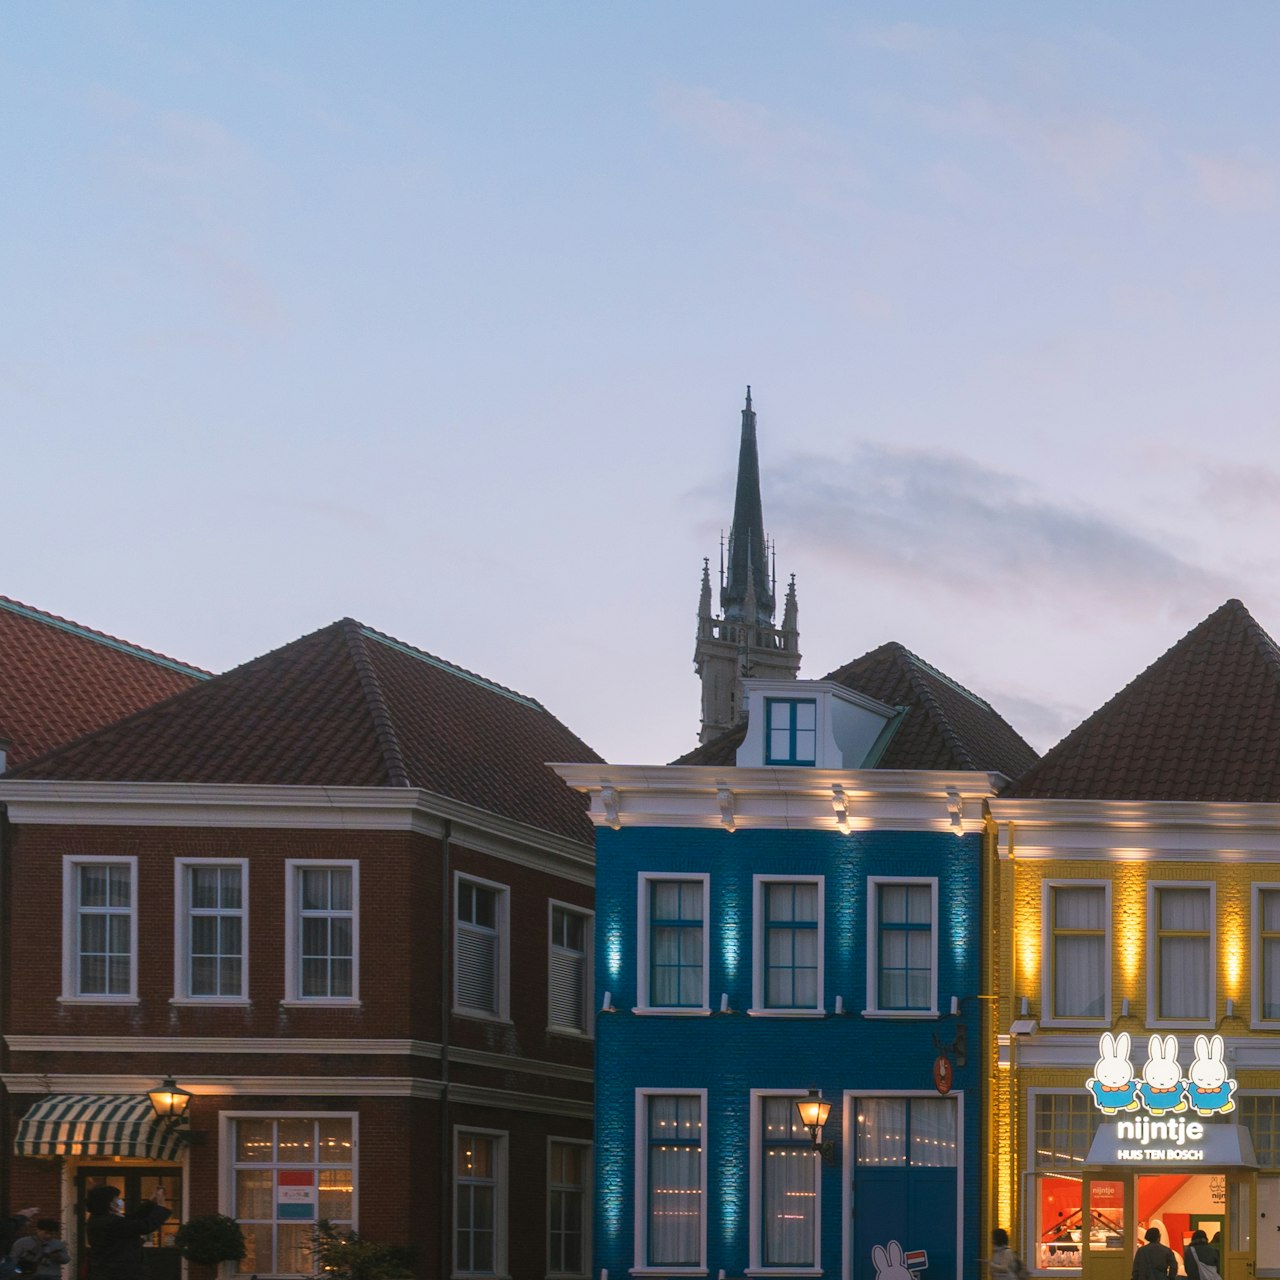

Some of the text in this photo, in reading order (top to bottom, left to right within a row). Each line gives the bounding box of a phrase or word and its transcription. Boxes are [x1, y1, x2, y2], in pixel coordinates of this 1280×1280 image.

[1117, 1115, 1204, 1145] nijntje
[1117, 1149, 1204, 1161] HUIS TEN BOSCH
[1092, 1186, 1115, 1195] nijntje
[1212, 1191, 1226, 1201] nijn
